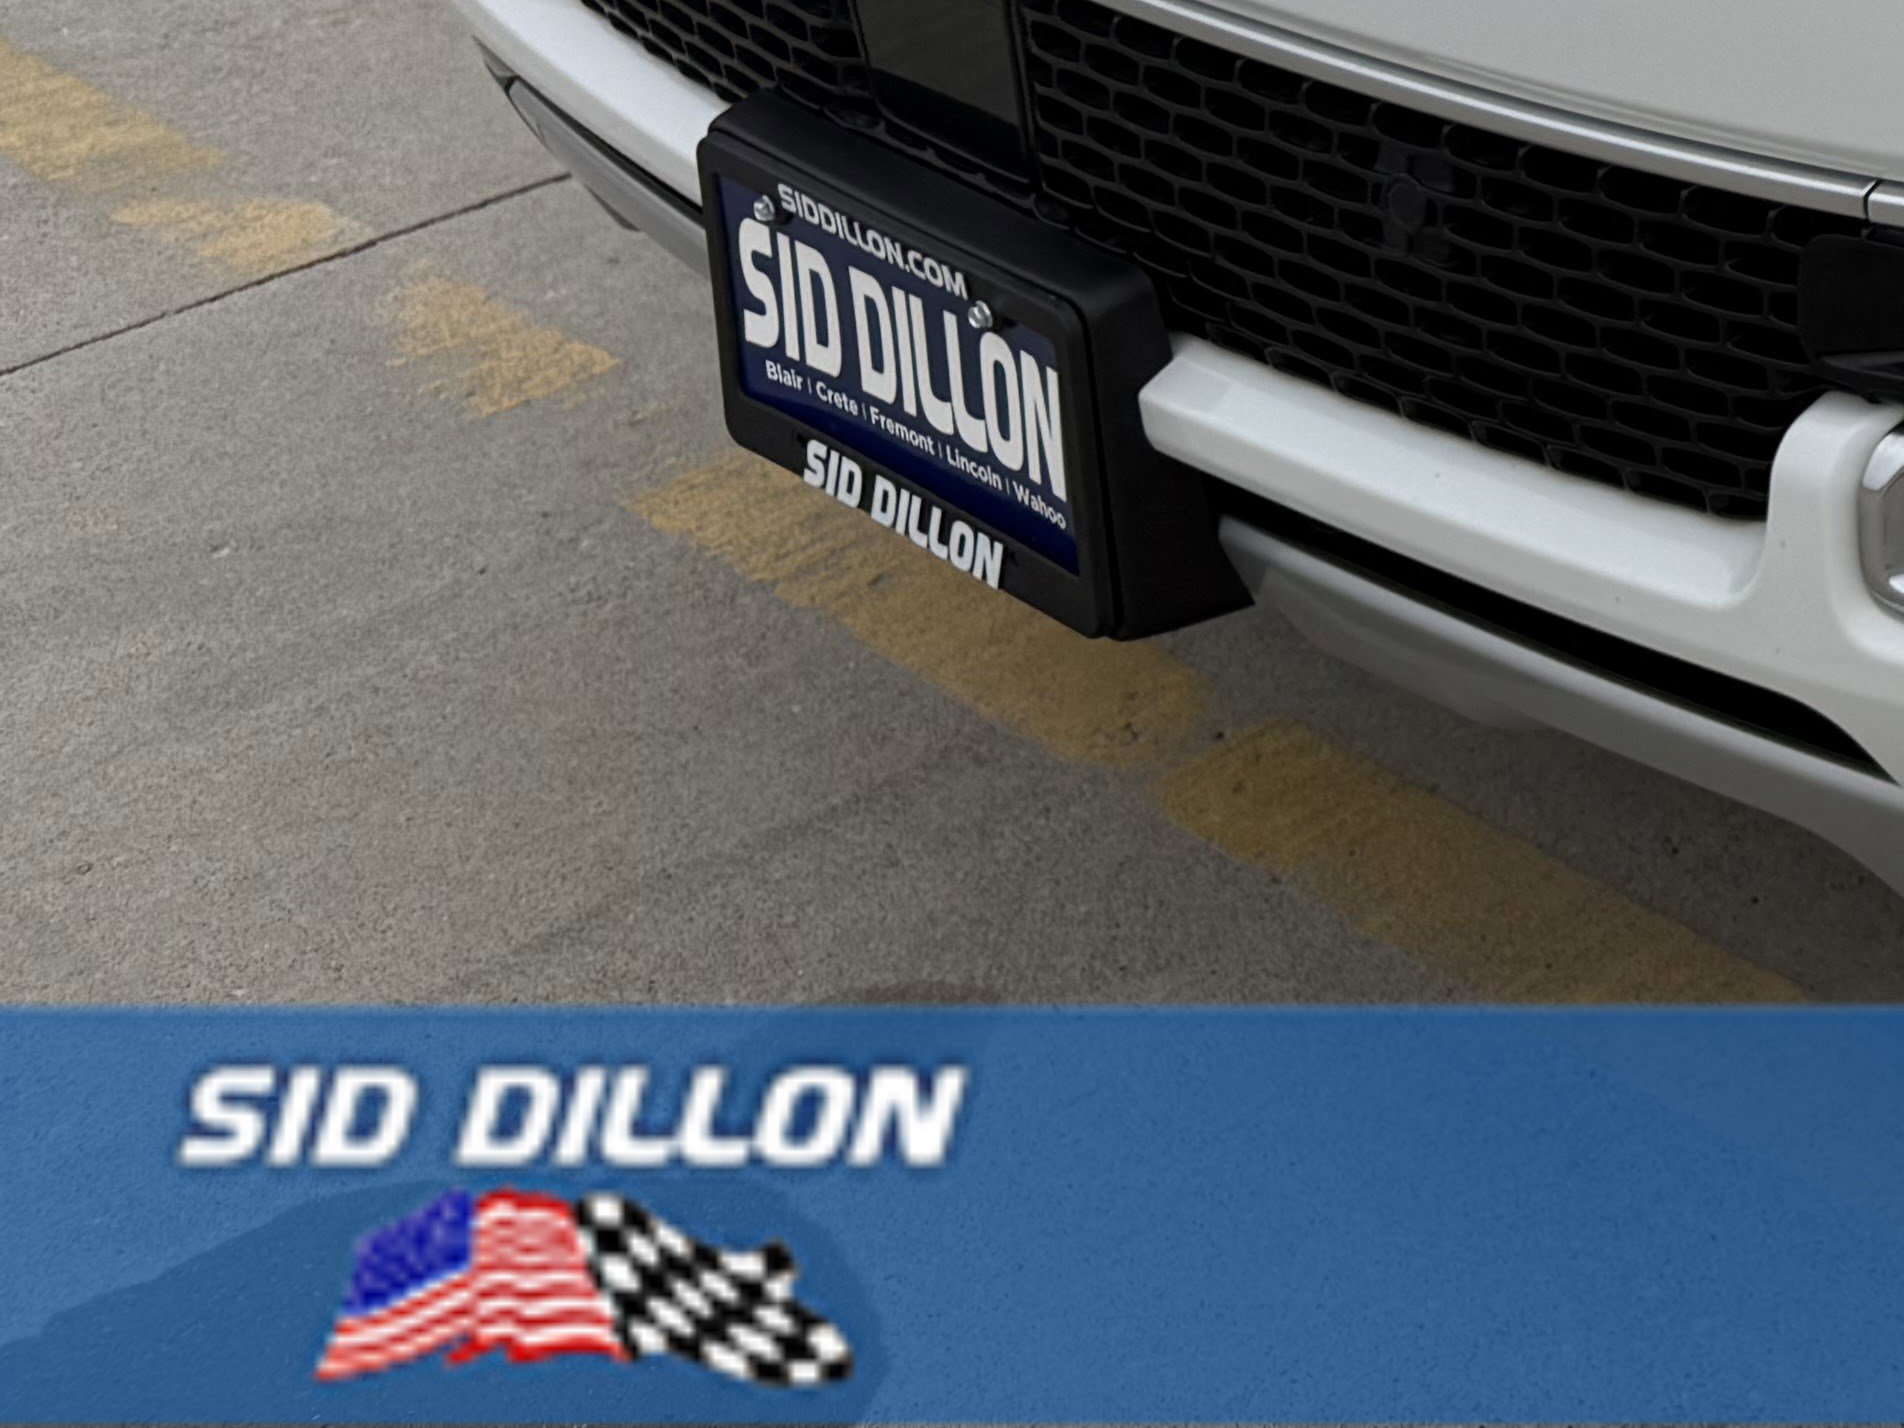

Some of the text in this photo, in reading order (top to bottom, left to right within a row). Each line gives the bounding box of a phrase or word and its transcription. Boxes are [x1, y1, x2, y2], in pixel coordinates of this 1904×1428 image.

[777, 183, 969, 301] SIDDILLON.COM
[738, 217, 1068, 503] SID DILLON
[765, 359, 1067, 530] Blair Crete Fremont Lincoln Wahoo
[803, 439, 1004, 591] SID DILLON
